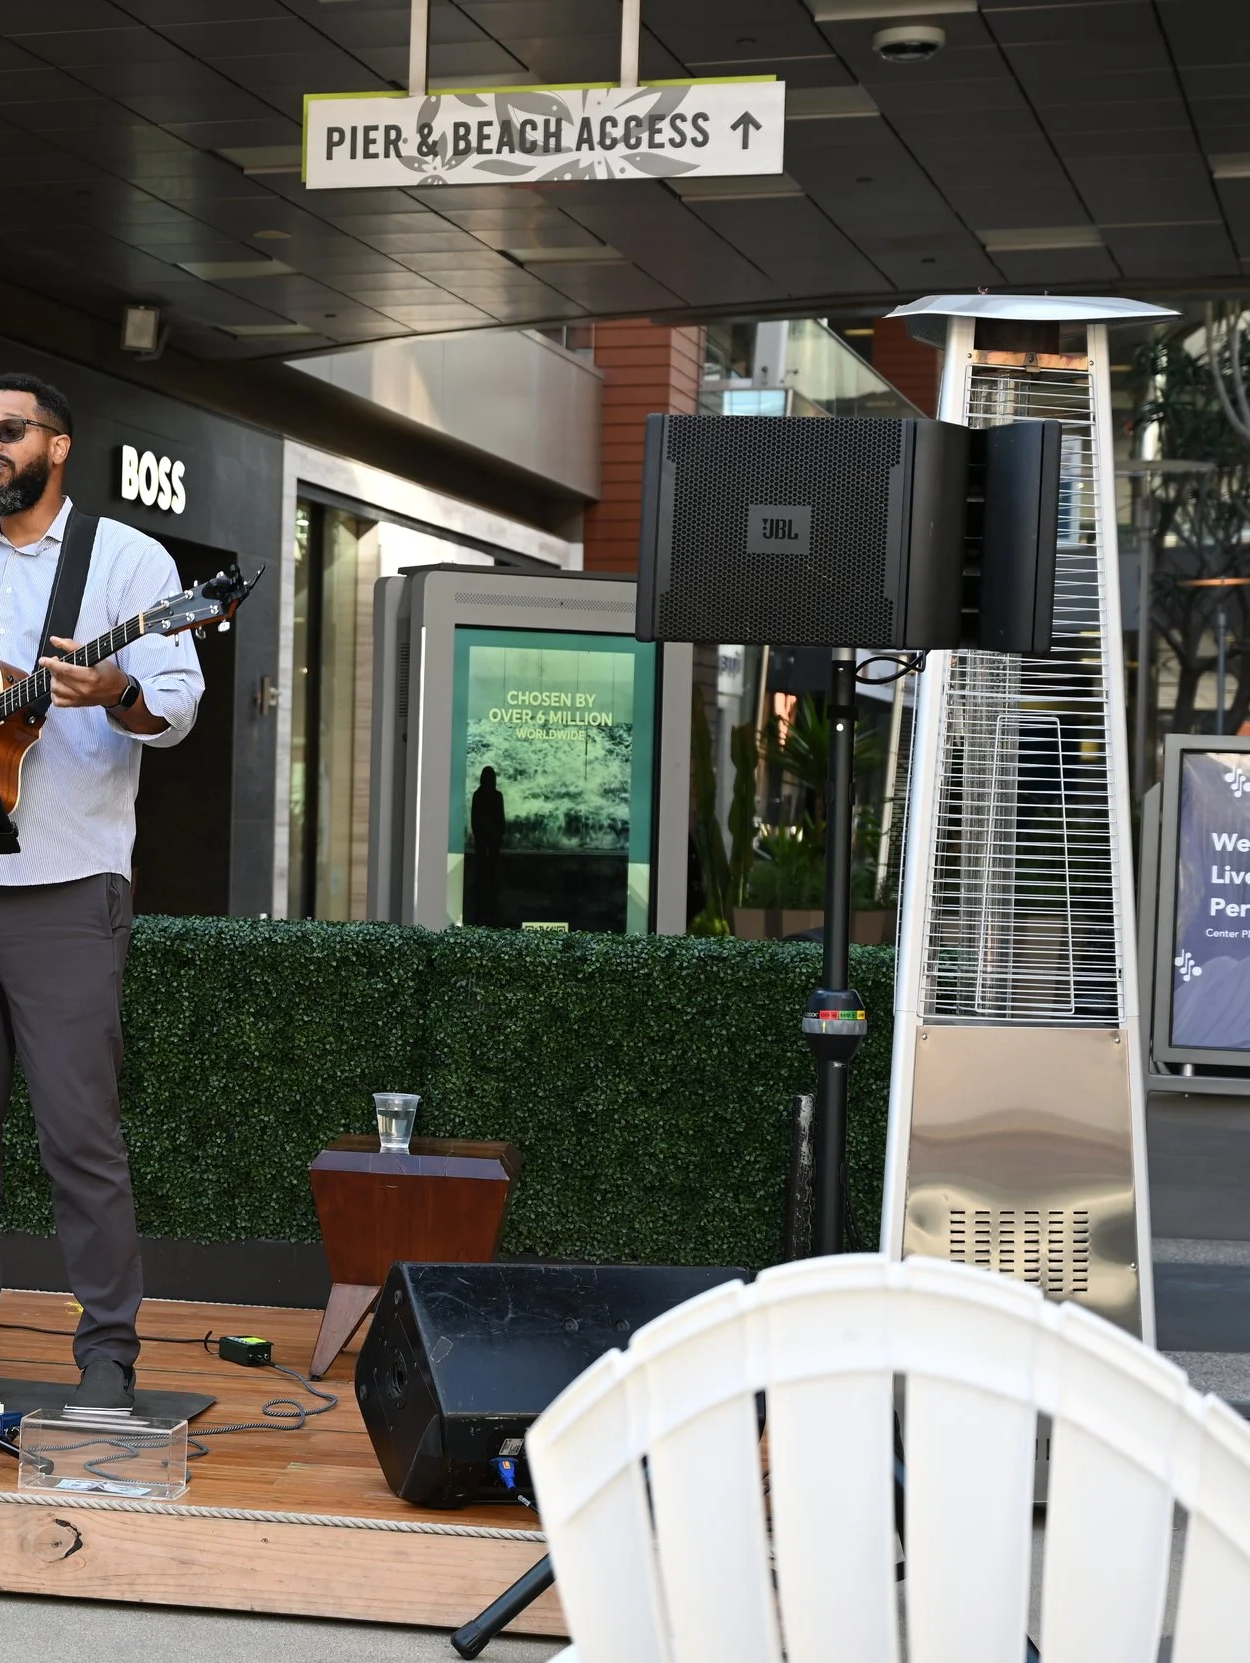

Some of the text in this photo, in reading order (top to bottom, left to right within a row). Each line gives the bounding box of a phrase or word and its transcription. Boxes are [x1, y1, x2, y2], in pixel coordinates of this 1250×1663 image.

[326, 111, 711, 161] PIER & BEACH ACCESS
[121, 444, 187, 515] BOSS
[762, 518, 799, 540] JBL
[507, 690, 597, 708] CHOSEN BY
[489, 708, 613, 727] OVER 6 MILLION
[516, 728, 586, 741] WORLDWIDE
[1205, 928, 1239, 938] Center
